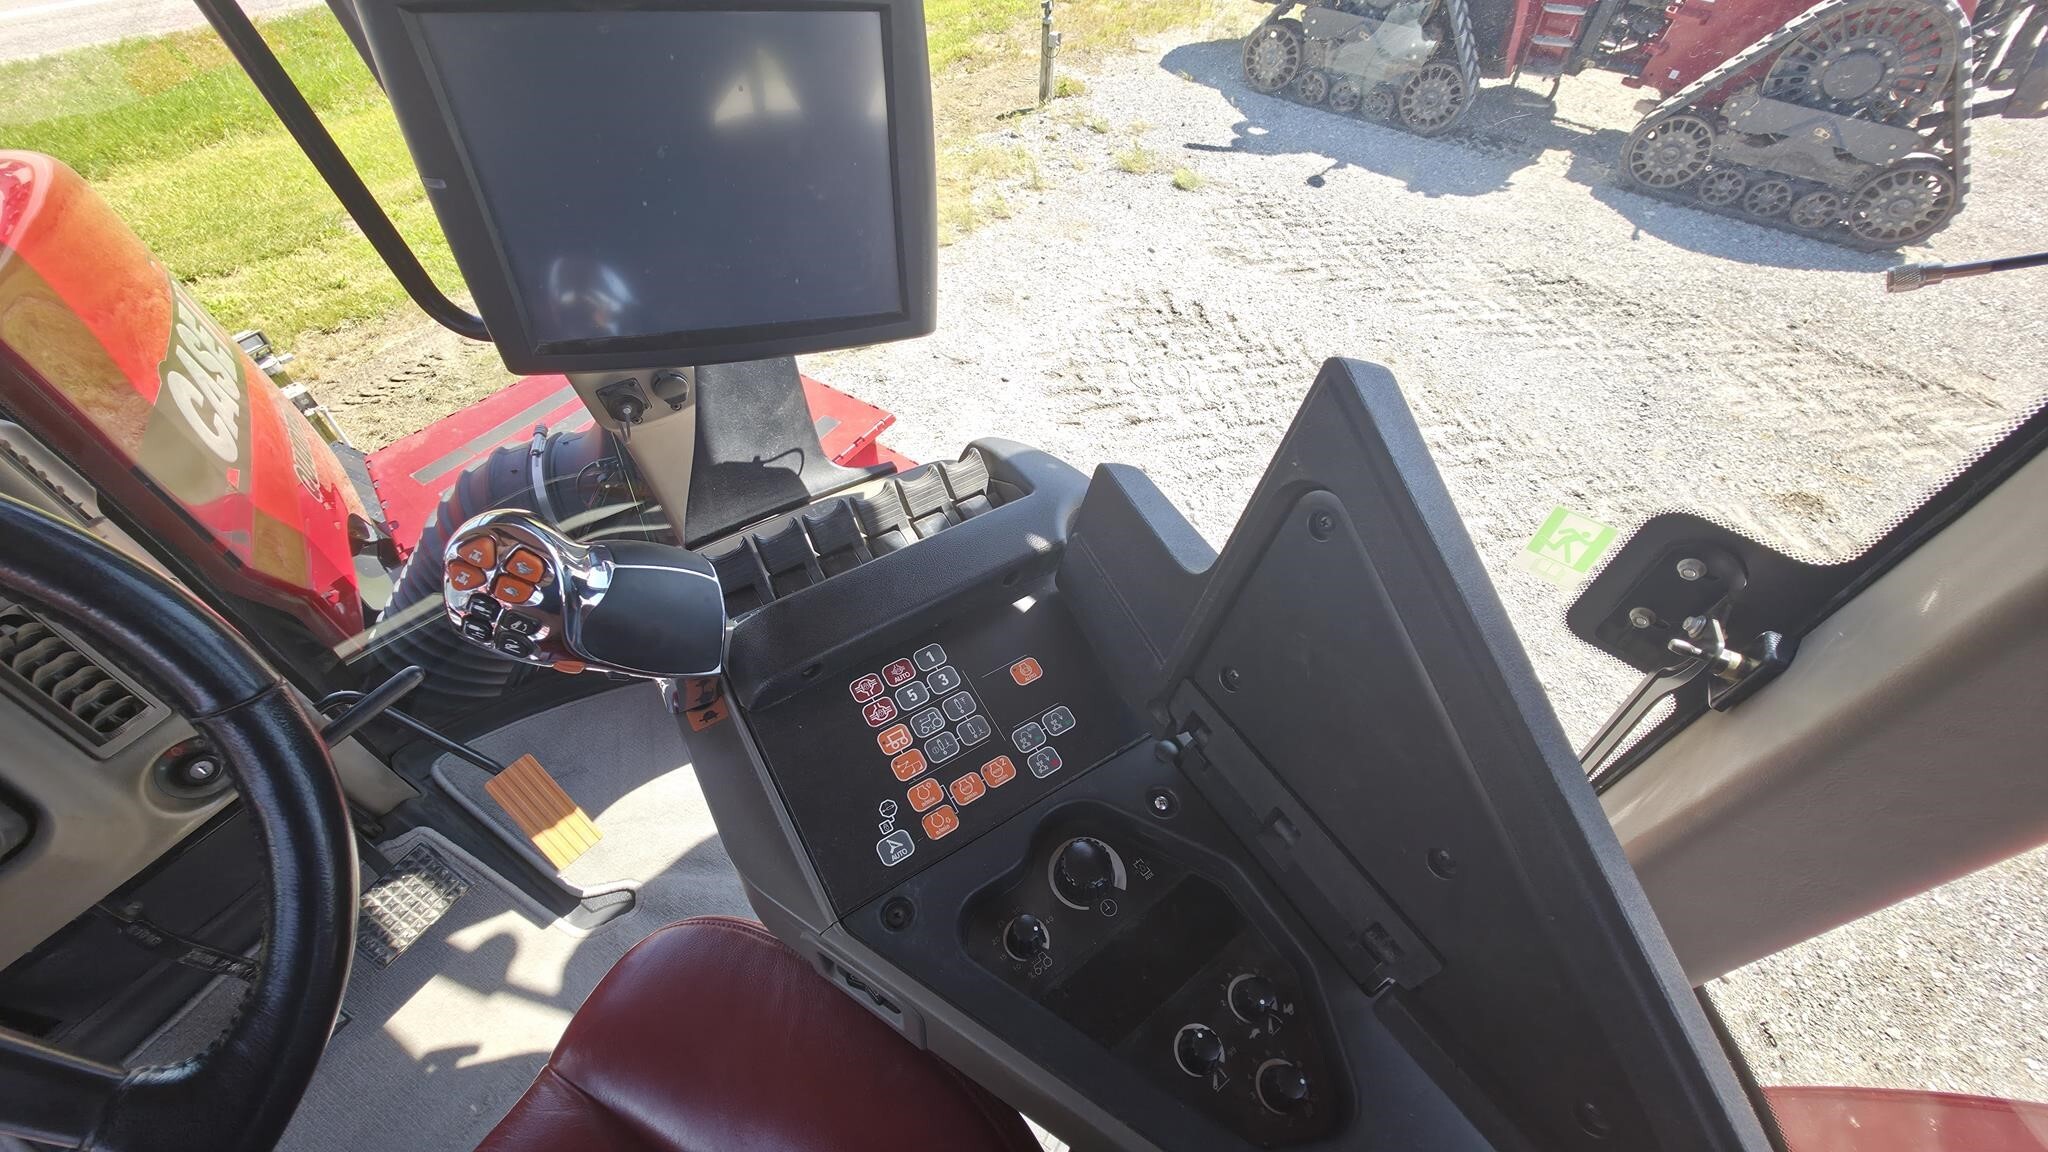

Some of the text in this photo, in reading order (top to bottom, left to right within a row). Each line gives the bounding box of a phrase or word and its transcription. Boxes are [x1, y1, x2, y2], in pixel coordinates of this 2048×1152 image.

[167, 301, 240, 464] CASE
[926, 651, 936, 662] 1
[894, 671, 911, 683] AUTO
[938, 673, 949, 686] 3
[906, 688, 918, 702] 5
[891, 848, 908, 861] AUTO
